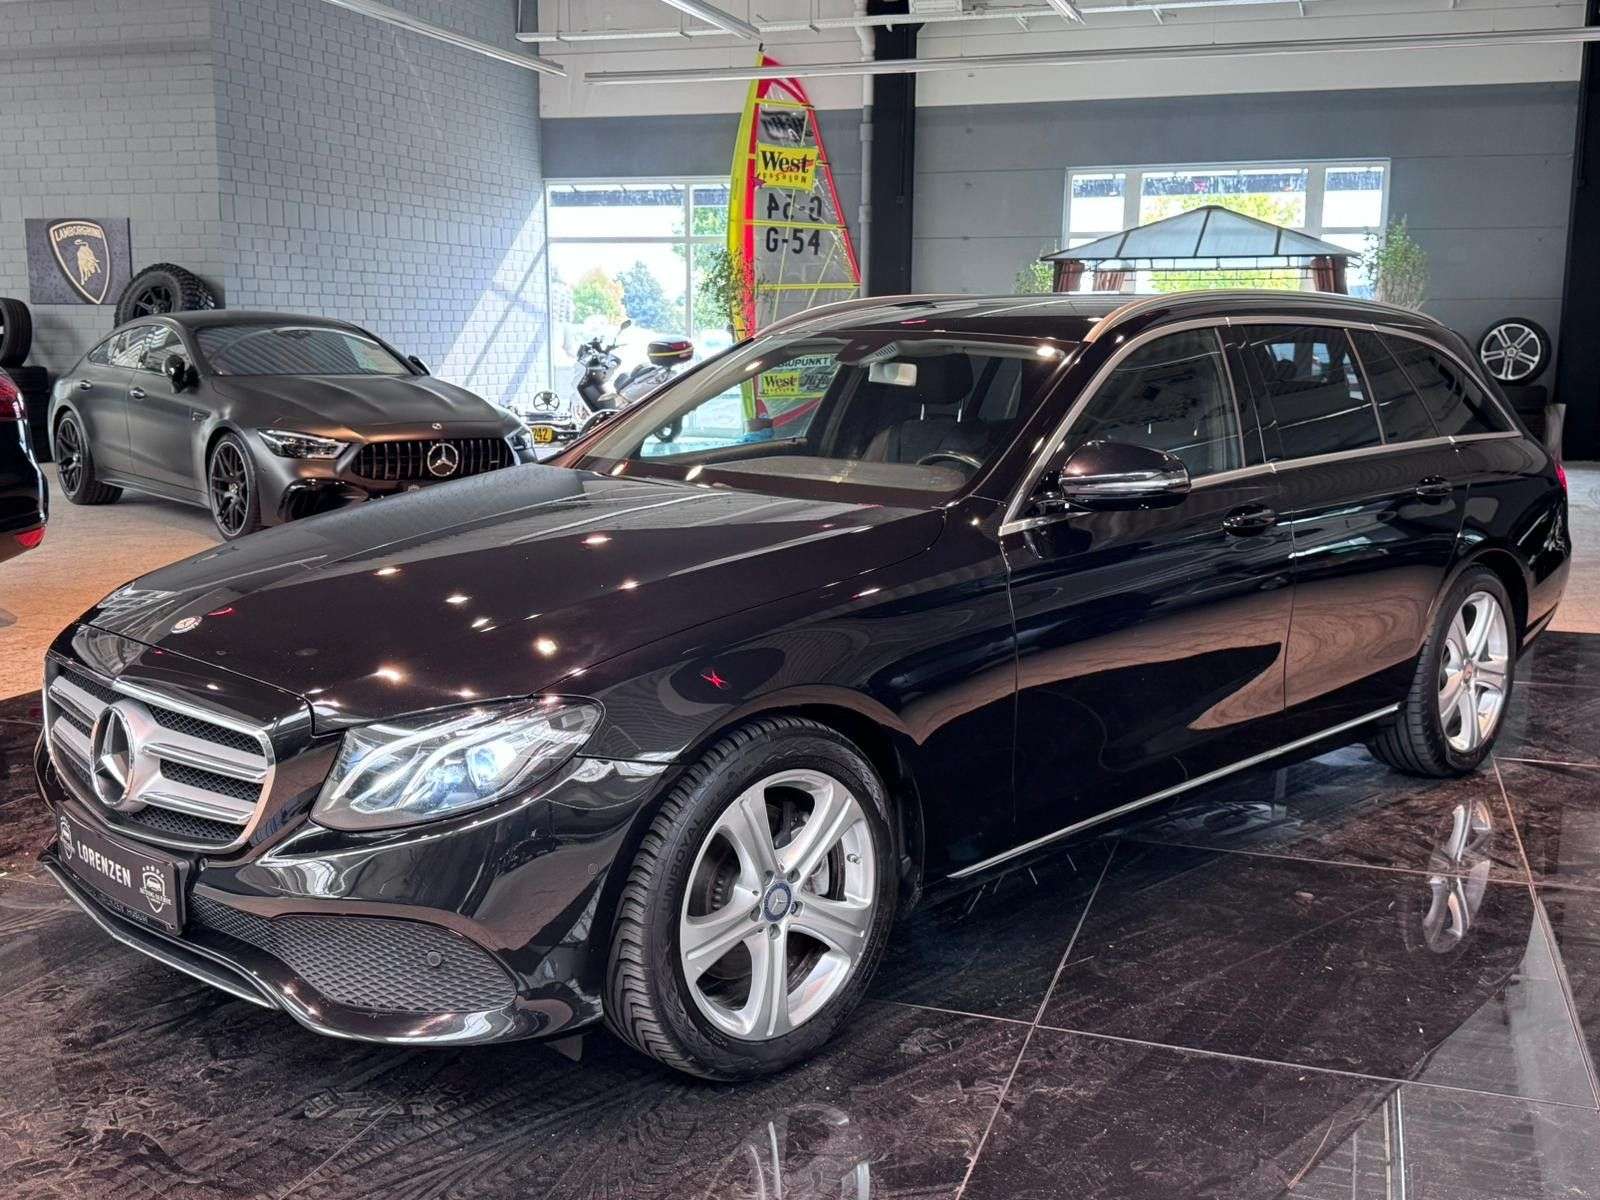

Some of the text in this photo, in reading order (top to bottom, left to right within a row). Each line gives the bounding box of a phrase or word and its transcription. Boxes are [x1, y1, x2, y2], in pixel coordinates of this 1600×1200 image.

[761, 150, 812, 173] West
[766, 227, 820, 255] G-54
[764, 374, 796, 388] West
[77, 840, 132, 888] LORENZEN
